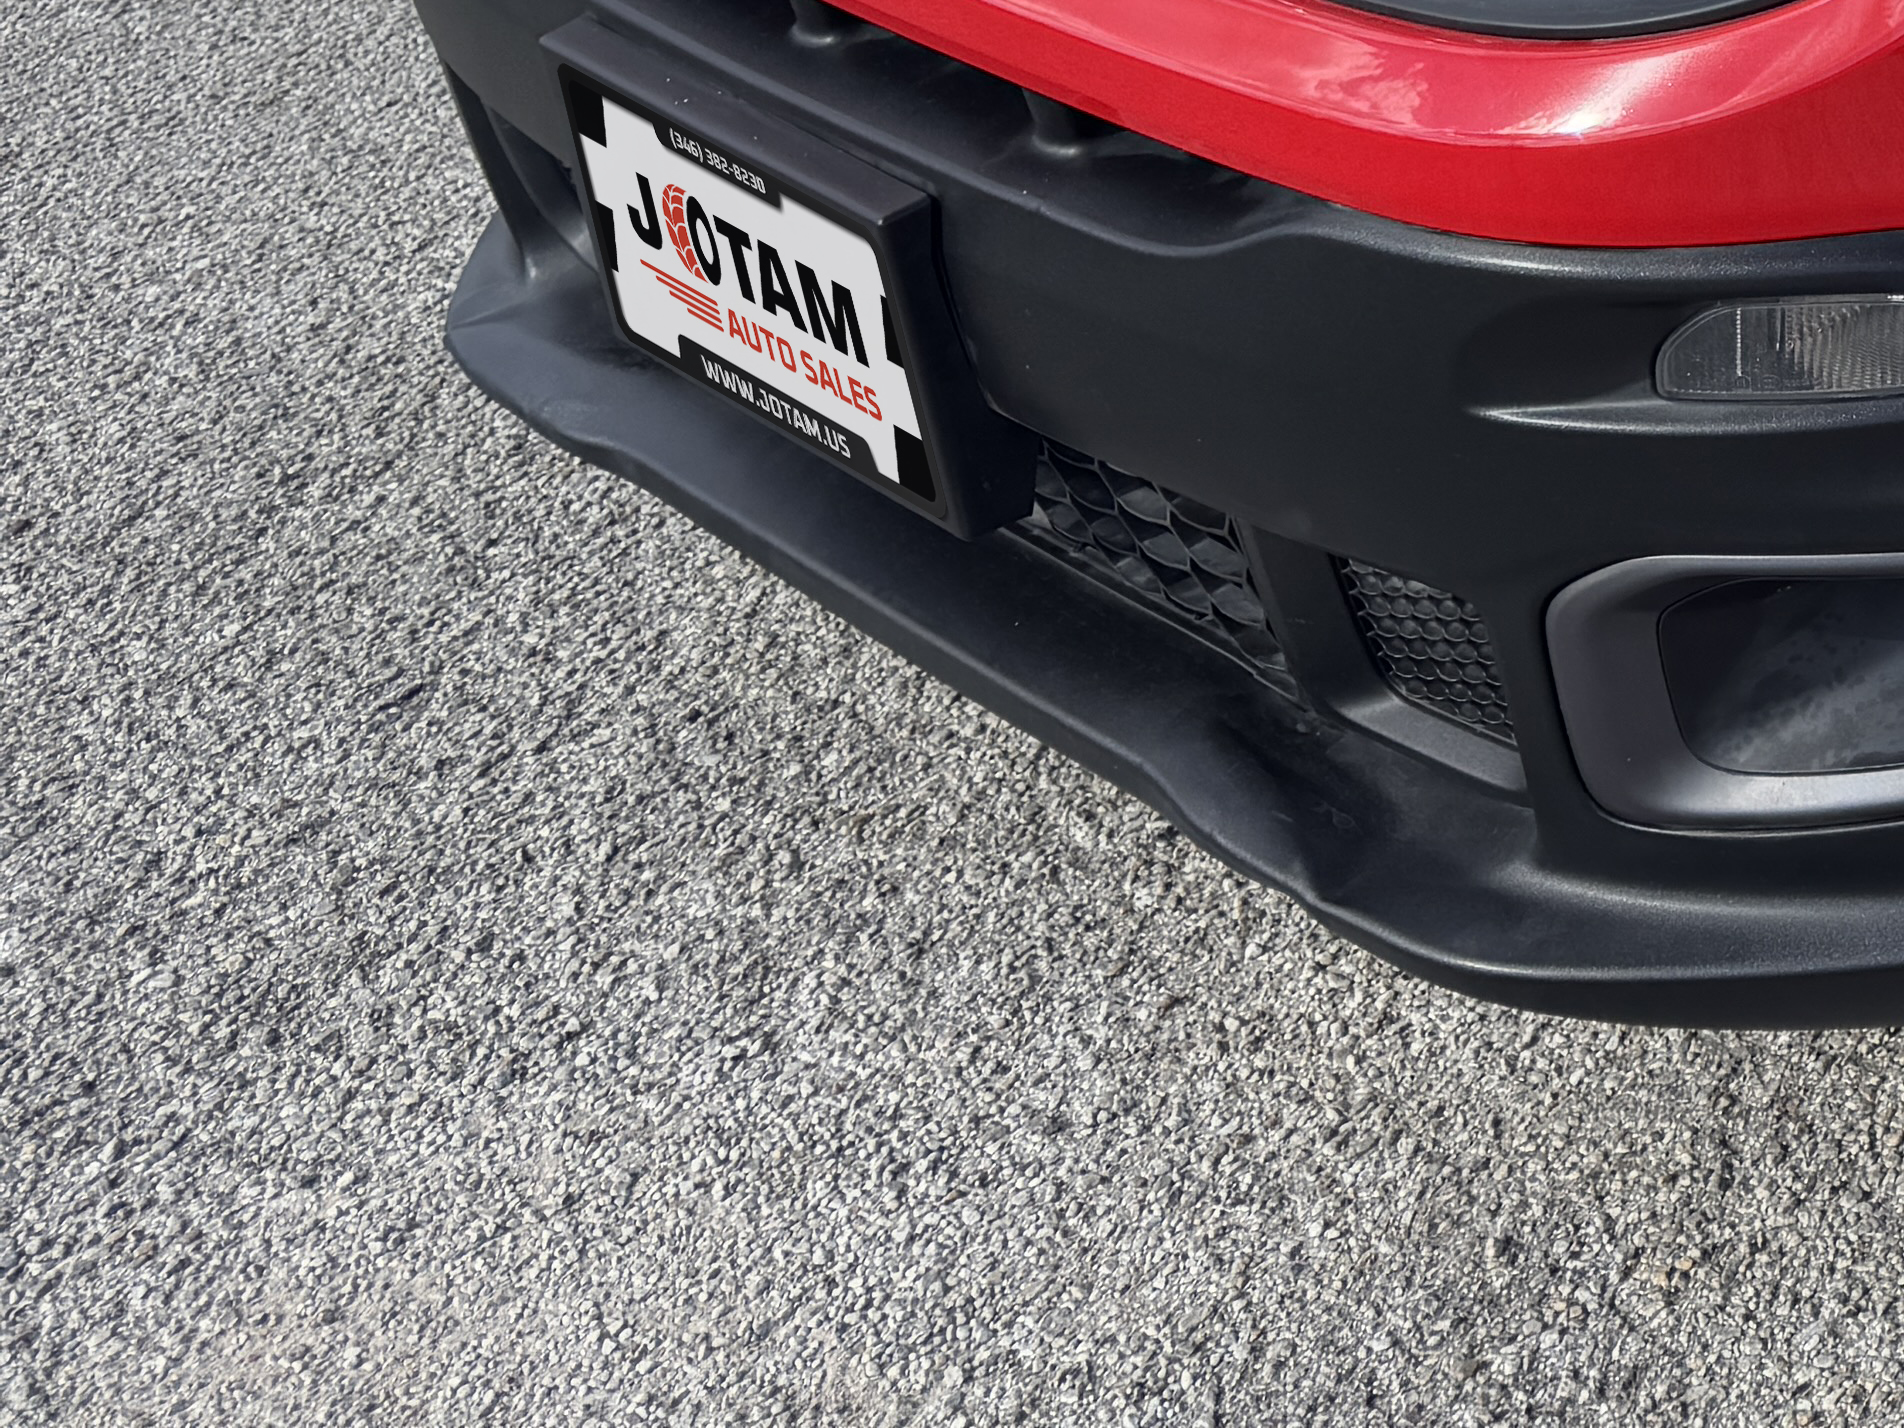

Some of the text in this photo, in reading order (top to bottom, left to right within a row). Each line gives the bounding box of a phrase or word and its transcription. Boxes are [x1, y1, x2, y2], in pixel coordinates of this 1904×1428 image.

[668, 126, 767, 195] (346) 382-8230
[626, 171, 871, 369] JOTAM
[700, 353, 852, 460] WWW.JOTAM.US
[727, 307, 883, 422] AUTO SALES
